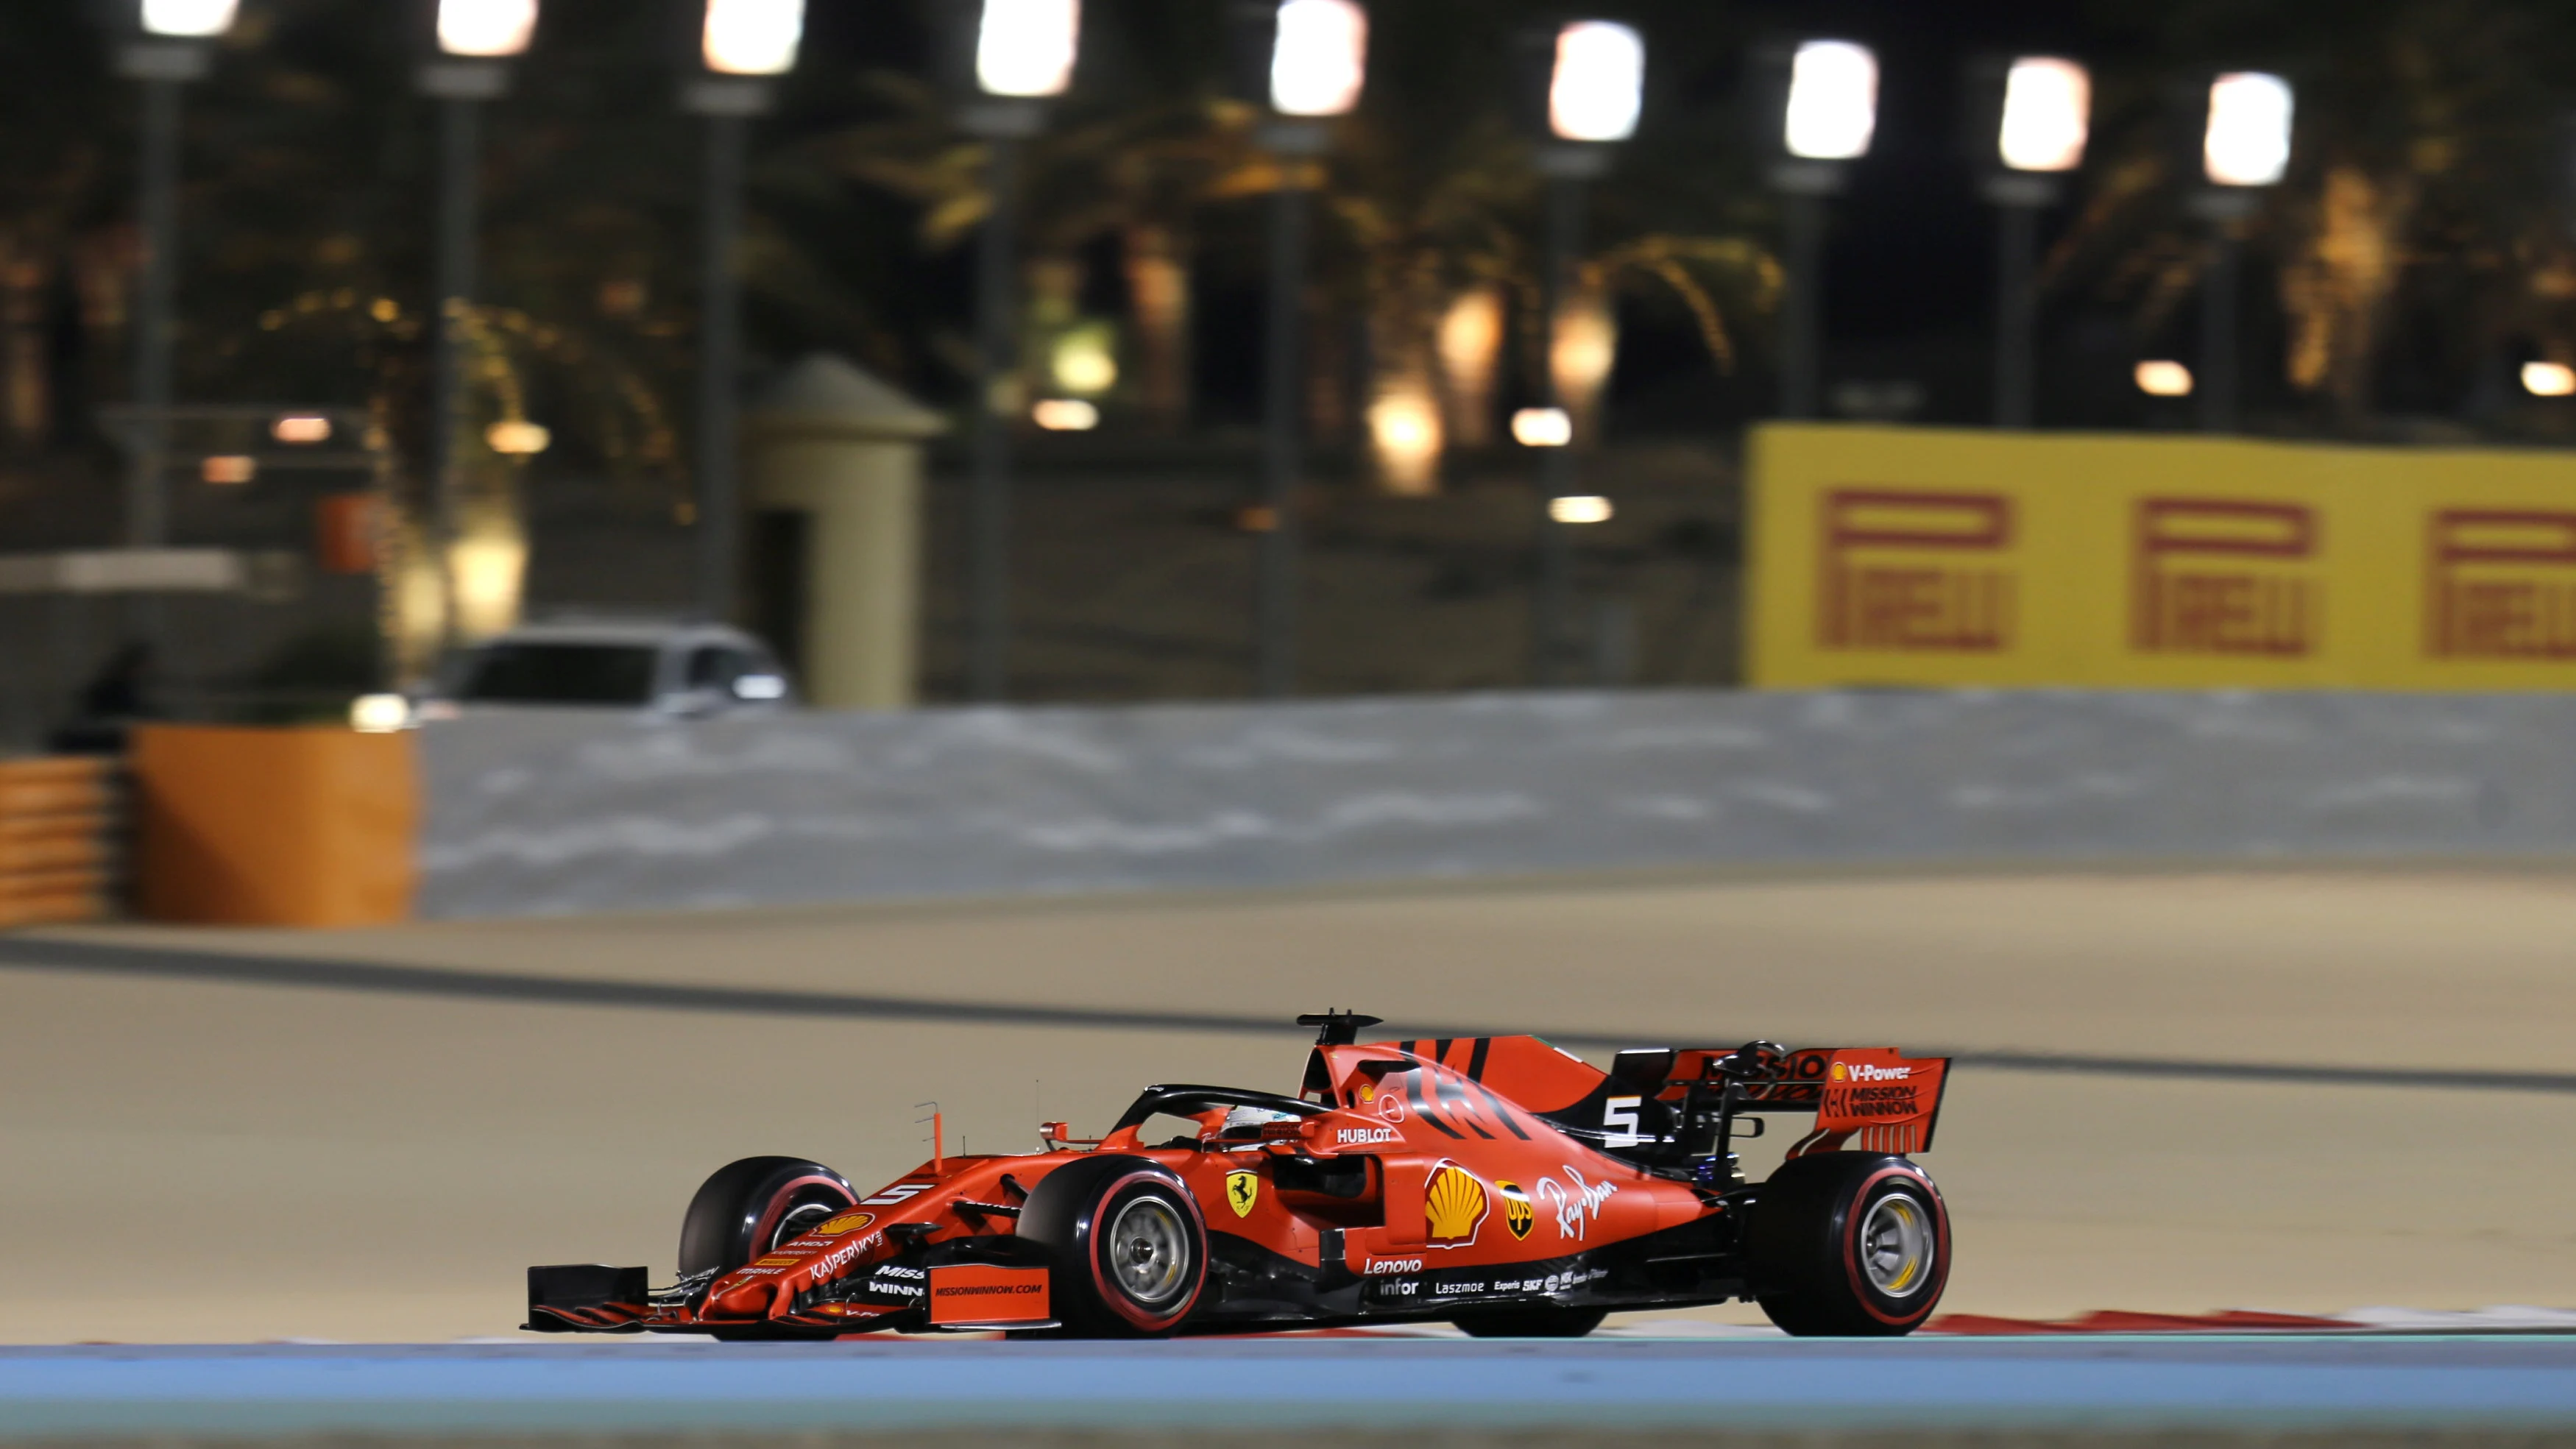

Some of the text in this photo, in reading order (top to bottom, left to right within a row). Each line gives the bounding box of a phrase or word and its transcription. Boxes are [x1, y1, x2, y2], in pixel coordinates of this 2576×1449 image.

[1849, 1064, 1911, 1083] V-Power
[1850, 1086, 1917, 1102] MISSION
[1850, 1101, 1917, 1117] WINNOW
[1604, 1096, 1641, 1148] 5
[1337, 1128, 1391, 1143] HUBLOT
[860, 1183, 935, 1205] 5
[1507, 1198, 1532, 1230] ups
[875, 1231, 883, 1247] lab
[810, 1233, 874, 1280] KASPERSKY
[1364, 1258, 1422, 1275] Lenovo
[935, 1284, 1043, 1297] MISSIONWINNOW.COM
[1380, 1278, 1419, 1296] infor
[1522, 1278, 1543, 1292] SKF
